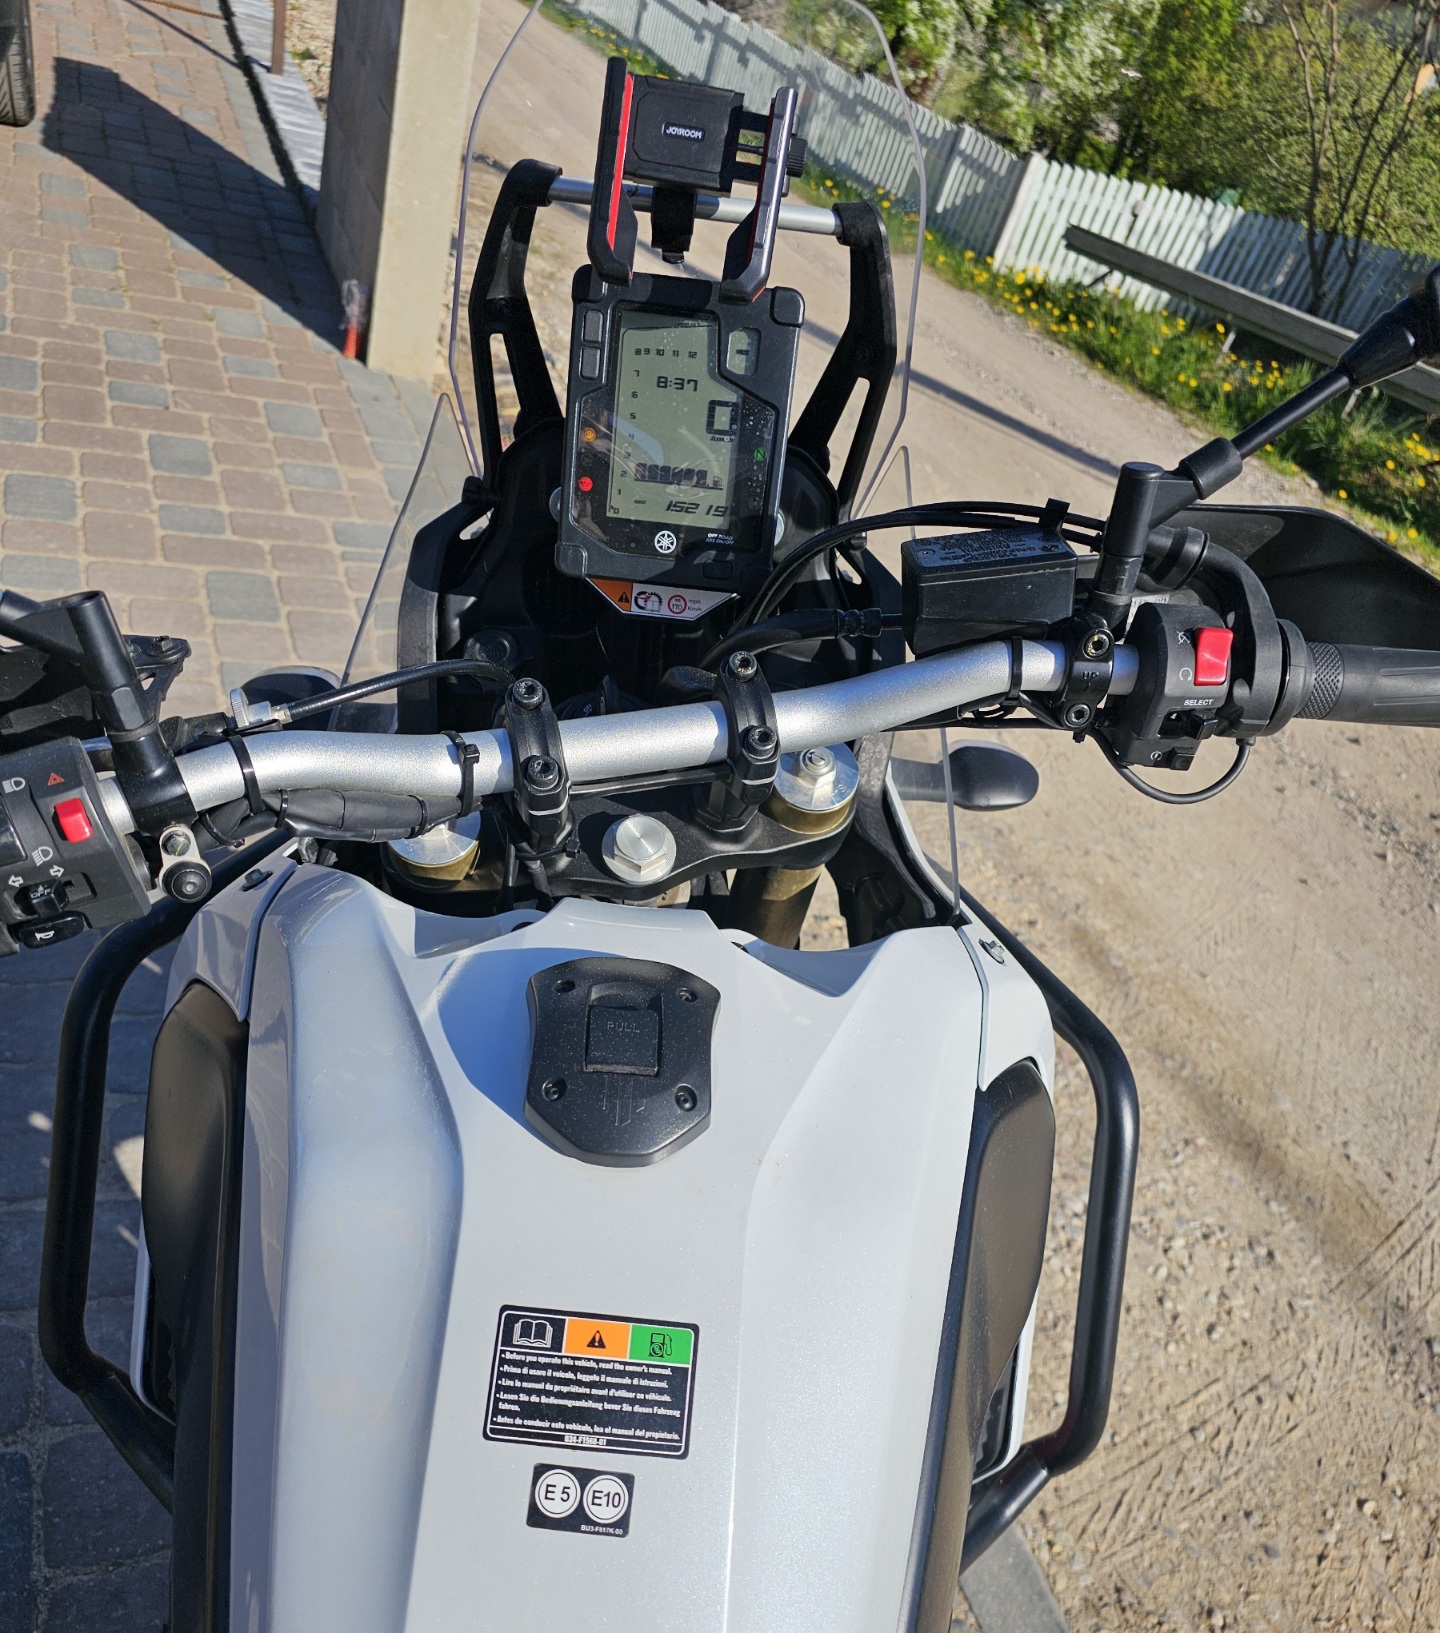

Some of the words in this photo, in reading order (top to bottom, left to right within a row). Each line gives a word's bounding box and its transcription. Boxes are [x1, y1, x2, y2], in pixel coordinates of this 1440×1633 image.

[666, 126, 702, 139] JOYROOM
[657, 376, 698, 391] 8:37
[1082, 671, 1099, 680] UP
[30, 888, 52, 898] OFF
[607, 1021, 640, 1033] PULL
[506, 1352, 525, 1360] Before
[575, 1360, 598, 1368] vehicle,
[504, 1365, 521, 1373] Prima
[502, 1378, 514, 1386] Lire
[500, 1391, 518, 1400] Lesen
[519, 1393, 529, 1401] Sie
[604, 1402, 621, 1410] bevor
[622, 1403, 632, 1411] Sie
[654, 1407, 681, 1417] Fahrzeug
[591, 1490, 621, 1508] E10
